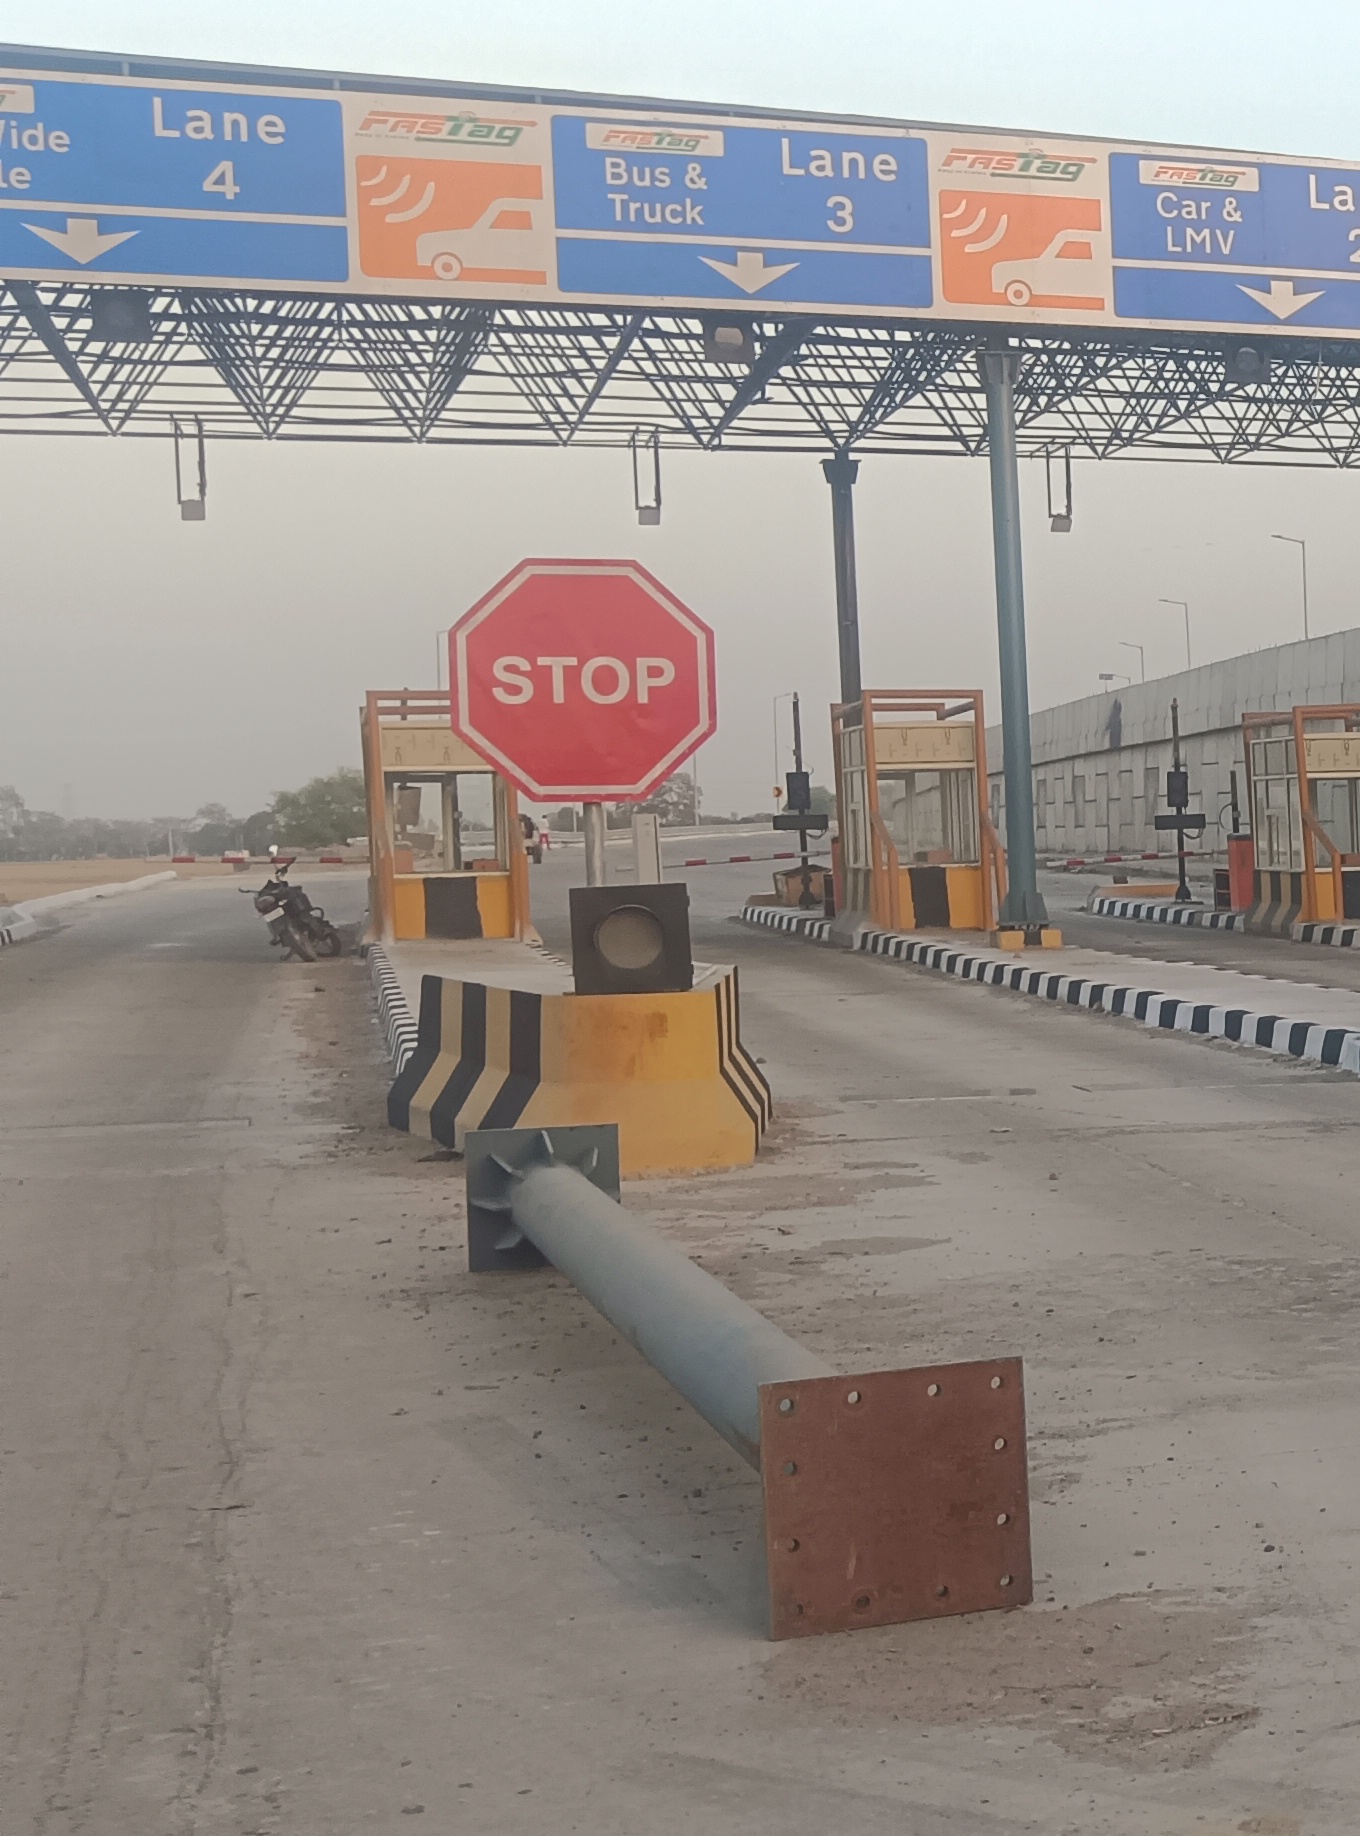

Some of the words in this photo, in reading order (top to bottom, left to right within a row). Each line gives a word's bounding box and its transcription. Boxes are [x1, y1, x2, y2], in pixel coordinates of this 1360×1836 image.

[0, 120, 70, 153] ide
[153, 97, 286, 144] Lane
[605, 157, 671, 188] Bus
[685, 163, 708, 189] &
[781, 137, 898, 182] Lane
[203, 160, 240, 200] 4
[607, 193, 705, 225] Truck
[826, 195, 854, 233] 3
[1156, 191, 1211, 219] Car
[1222, 197, 1243, 222] &
[1166, 226, 1235, 255] LMV
[492, 655, 676, 705] STOP
